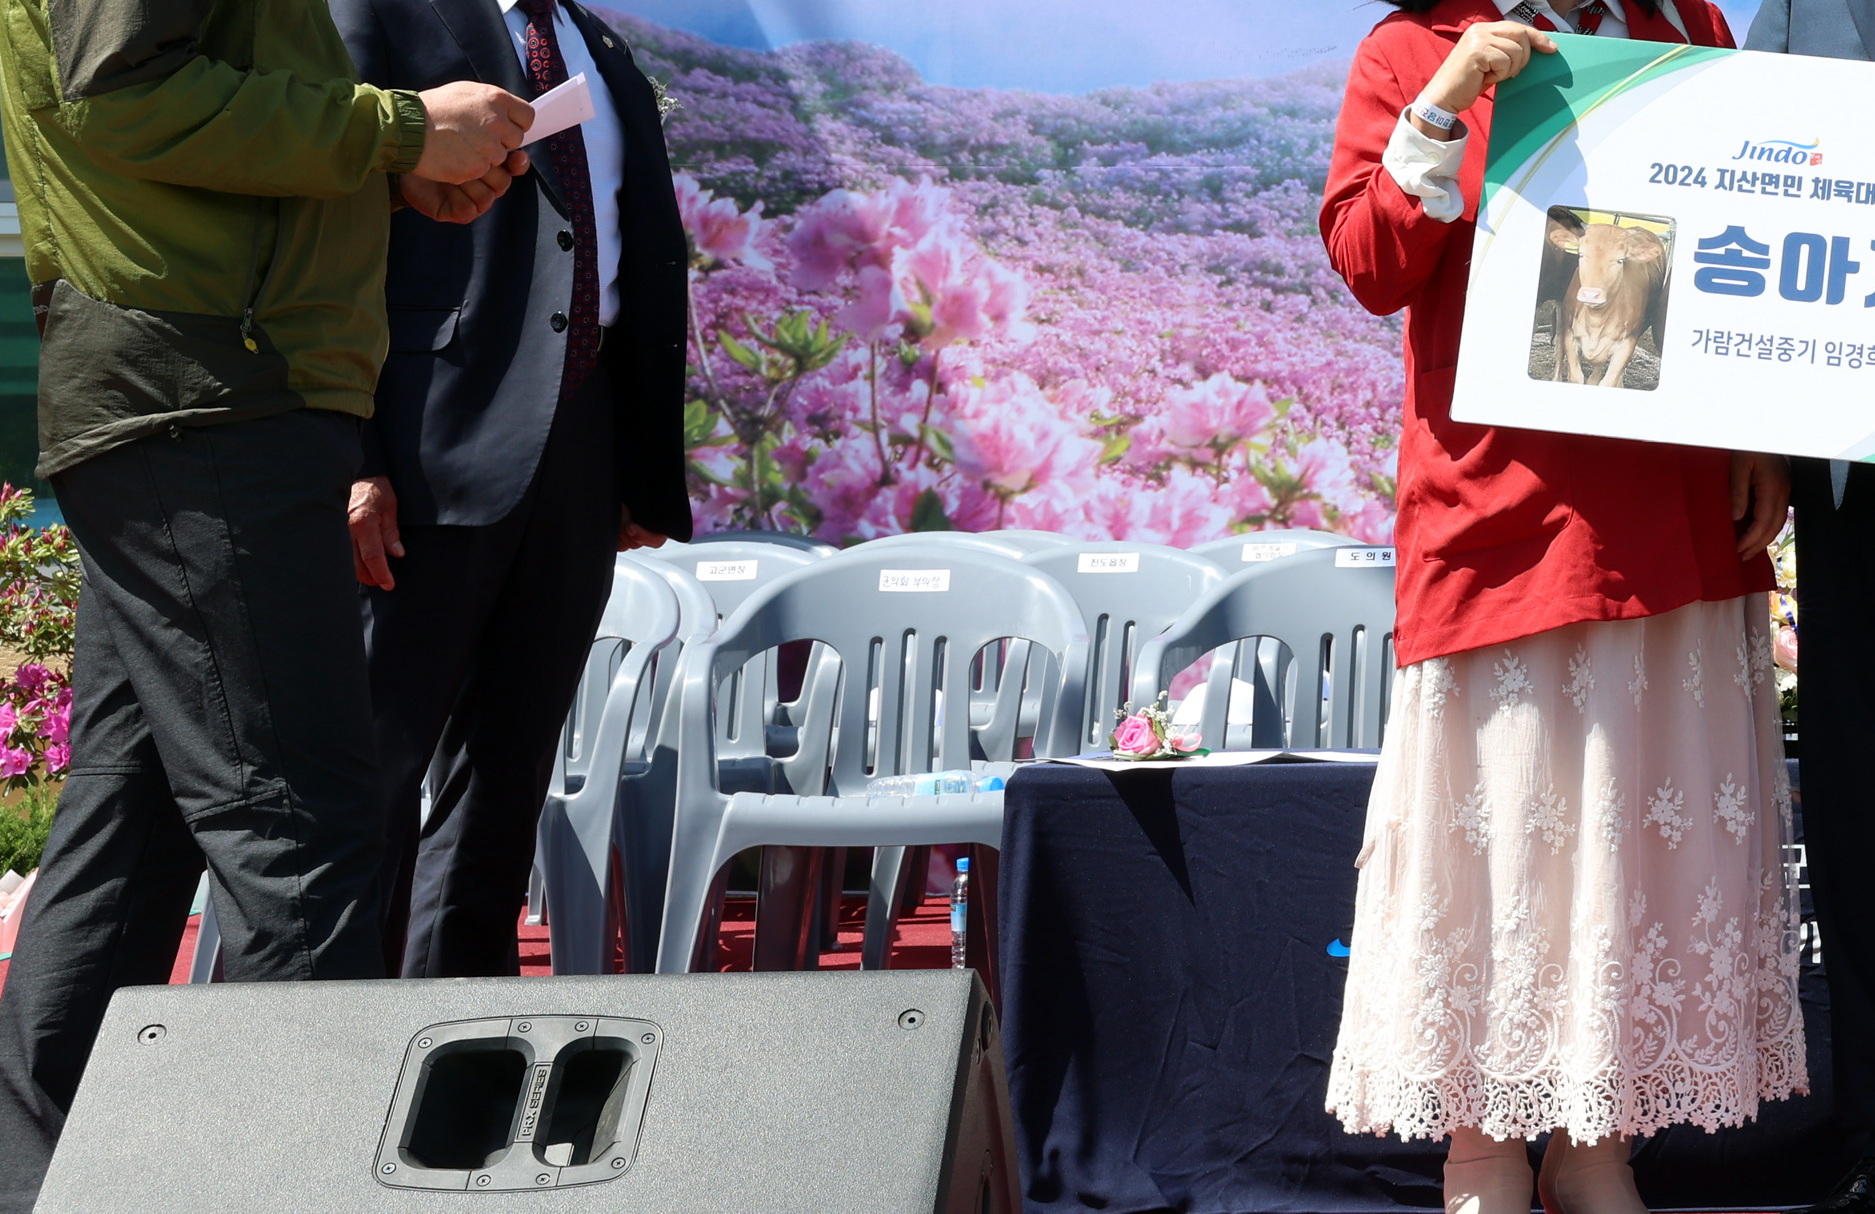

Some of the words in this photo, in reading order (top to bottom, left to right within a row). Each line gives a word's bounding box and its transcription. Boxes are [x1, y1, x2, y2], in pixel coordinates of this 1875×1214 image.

[1732, 140, 1808, 165] Jindo
[1648, 162, 1708, 190] 2024
[1714, 167, 1803, 199] 지산면민
[1691, 328, 1816, 367] 가람건설중기
[522, 1110, 537, 1136] PRX
[531, 1069, 547, 1108] SERIES
